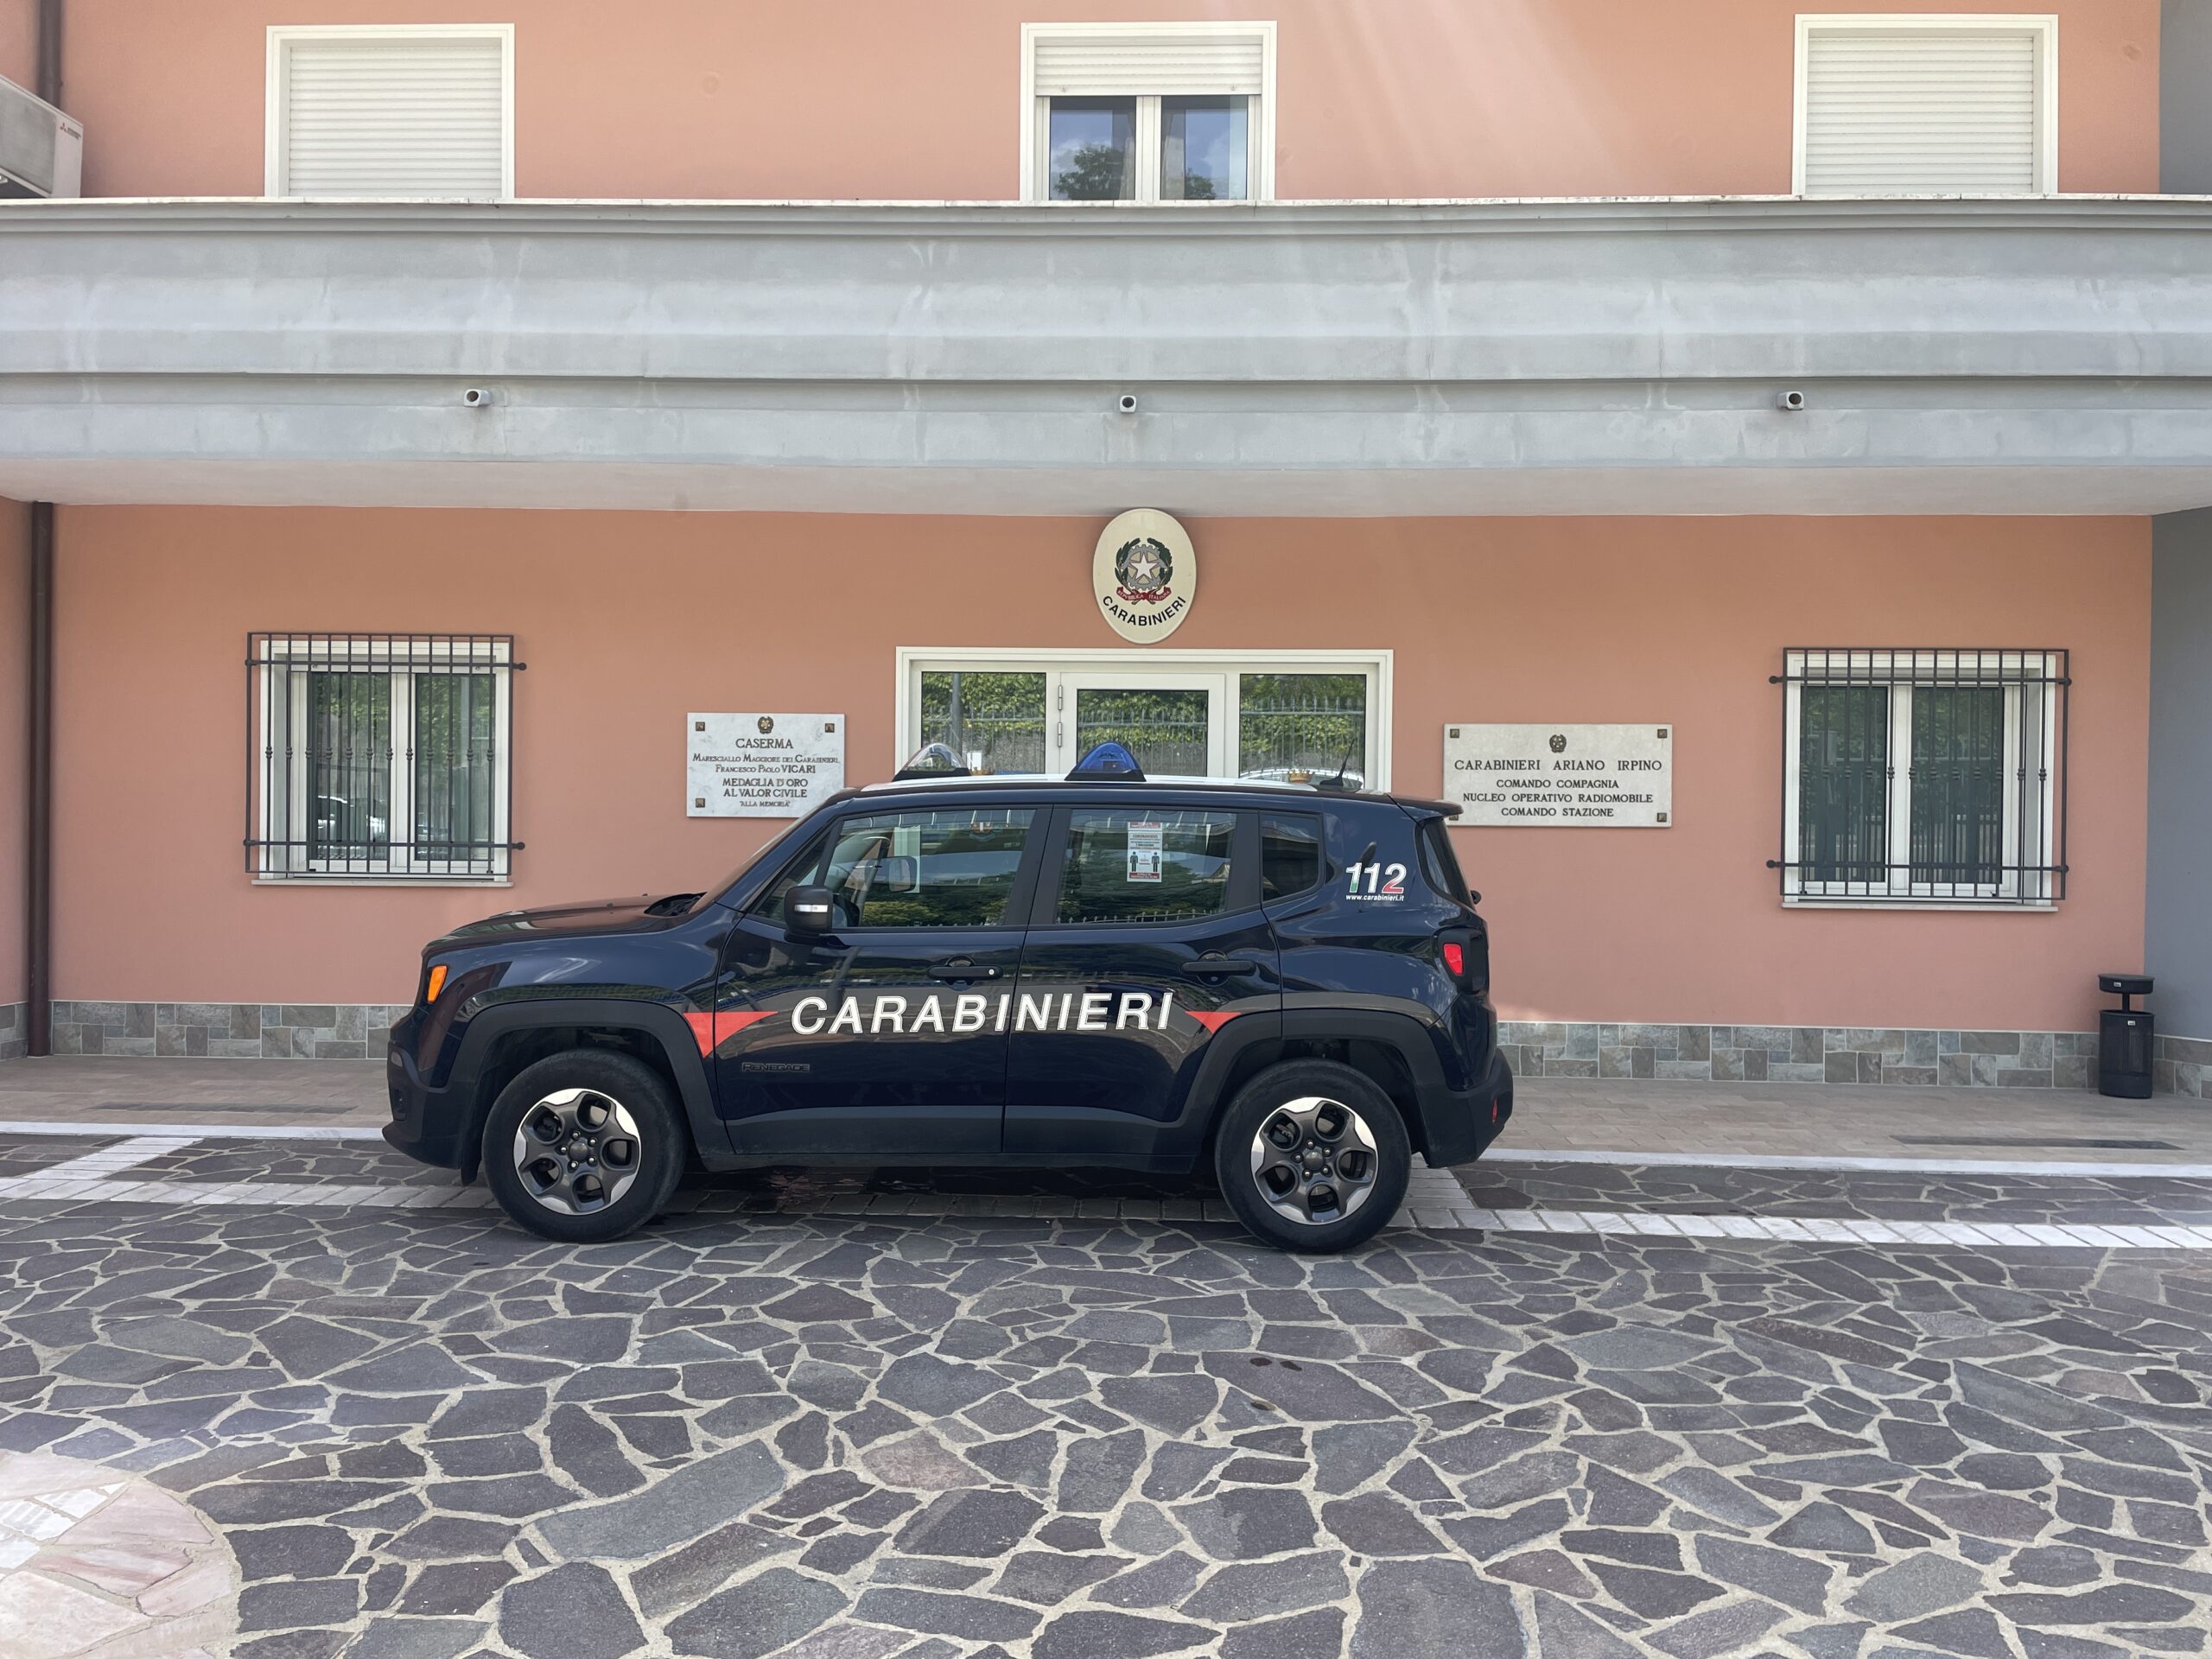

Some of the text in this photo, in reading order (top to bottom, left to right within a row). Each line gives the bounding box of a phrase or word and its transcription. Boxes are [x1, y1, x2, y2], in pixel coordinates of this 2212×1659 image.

[1103, 595, 1186, 626] CARABINIERI
[735, 739, 794, 749] CASERMA
[715, 764, 816, 774] FRANCESCO PAOLO VICARI
[1454, 760, 1662, 772] CARABINIERI ARIANO IRPINO
[722, 778, 774, 787] MEDAGLIA
[1496, 779, 1619, 789] COMANDO COMPAGNIA
[723, 788, 808, 798] AL VALOR CIVILE
[1463, 792, 1654, 804] NUCLEO OPERATIVO RADIOMOBILE
[1501, 807, 1614, 817] COMANDO STAZIONE
[1345, 862, 1407, 894] 112
[791, 992, 1173, 1034] CARABINIERI
[741, 1062, 810, 1072] RENEGADE
